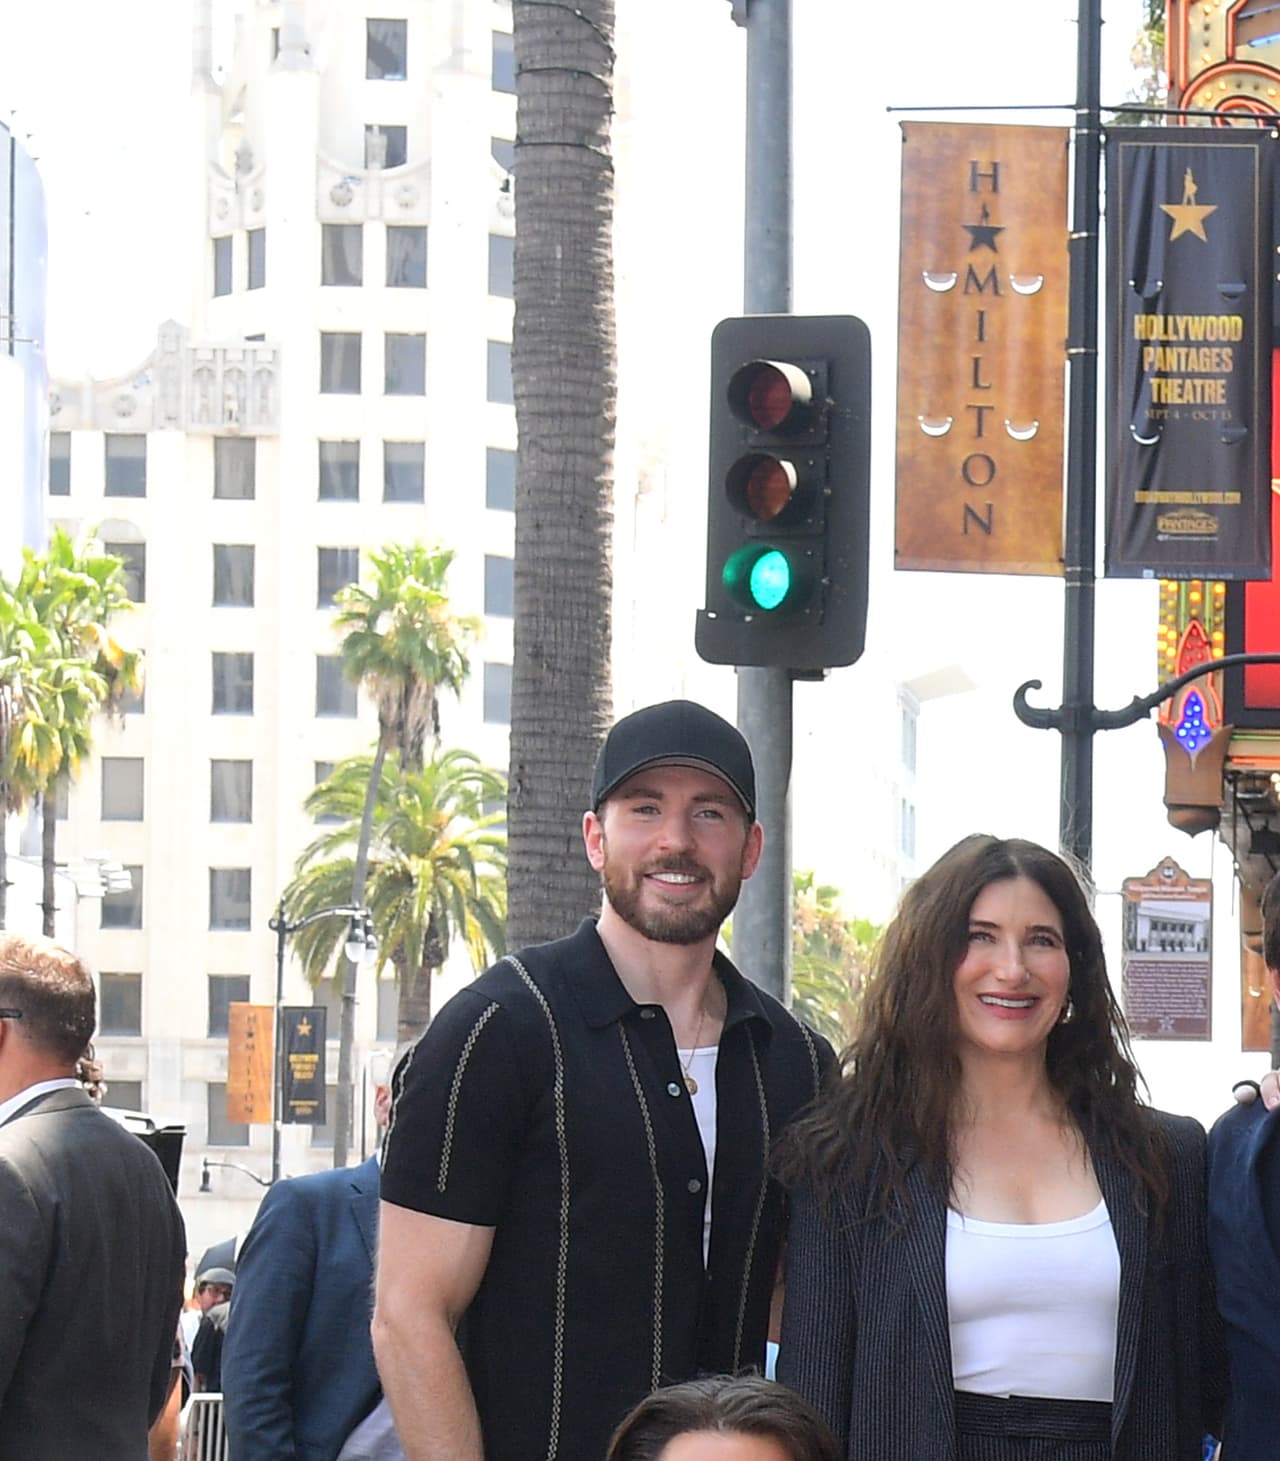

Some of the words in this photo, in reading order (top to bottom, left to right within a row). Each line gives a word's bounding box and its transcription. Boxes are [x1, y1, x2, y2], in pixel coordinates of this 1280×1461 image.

[1134, 314, 1243, 342] HOLLYWOOD
[1143, 347, 1233, 373] PANTAGES
[1149, 378, 1227, 404] THEATRE
[1192, 410, 1216, 421] OCT
